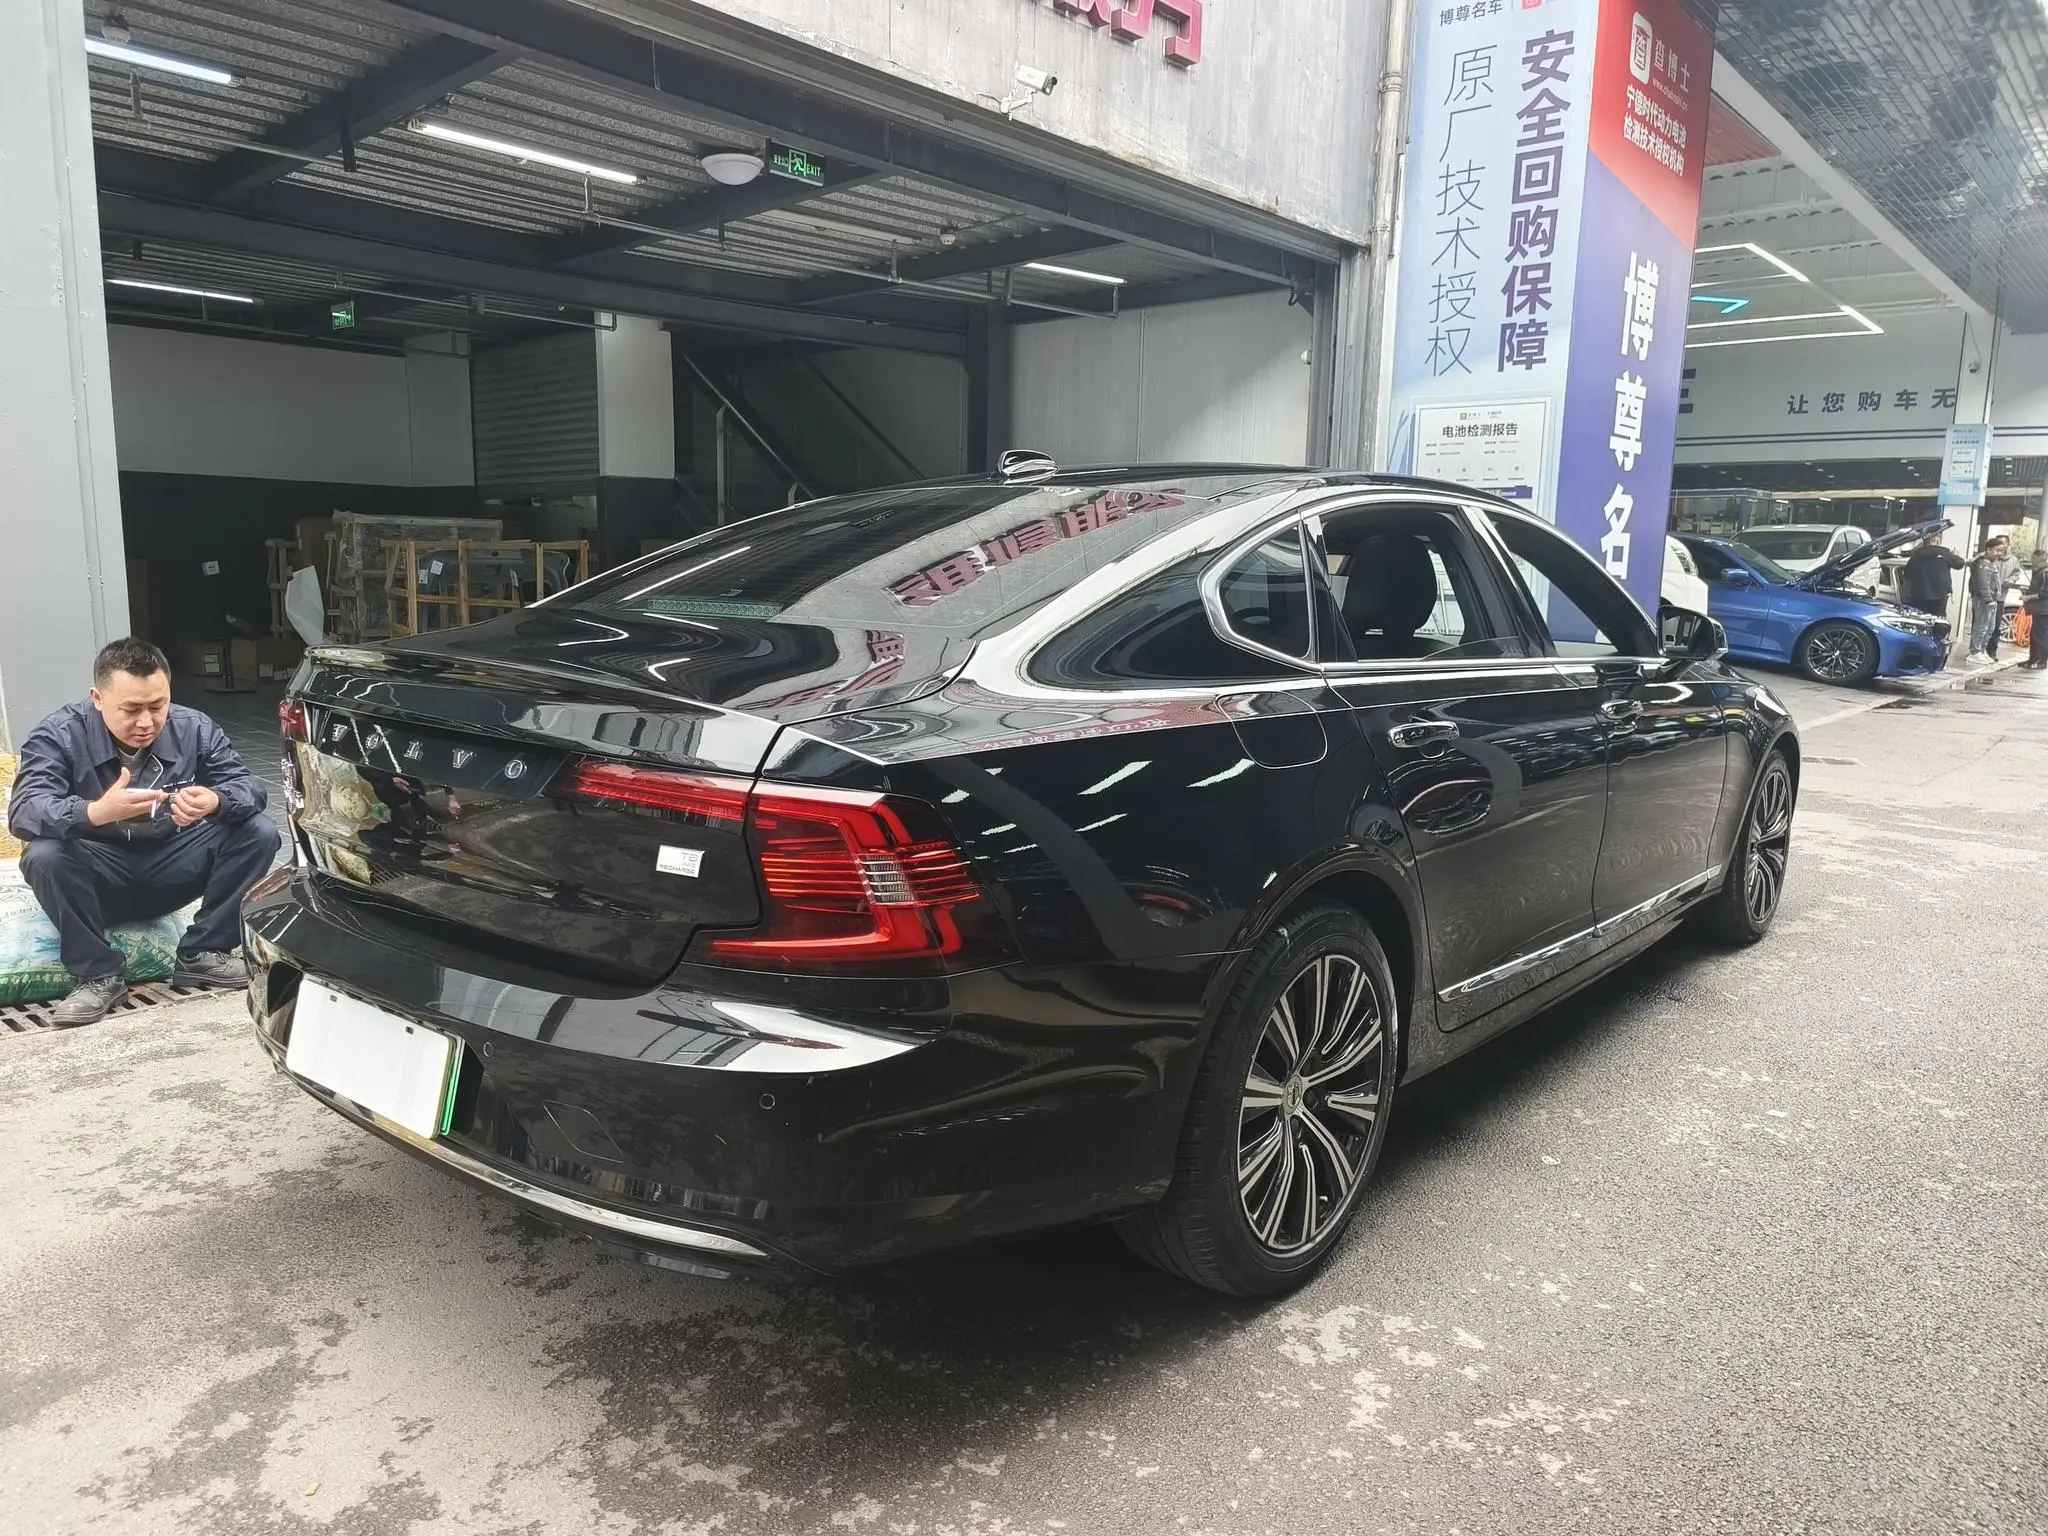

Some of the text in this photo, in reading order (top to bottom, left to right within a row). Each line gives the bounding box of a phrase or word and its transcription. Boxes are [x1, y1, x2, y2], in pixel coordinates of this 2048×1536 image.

[1440, 0, 1503, 27] 博尊名车
[1623, 112, 1685, 177] 检测技术授权机构
[1626, 84, 1687, 149] 宁德时代动力电池
[806, 164, 821, 177] EXIT
[1424, 44, 1498, 377] 原厂技术授权
[1498, 29, 1575, 373] 安全回购保障
[1442, 422, 1519, 438] 电池检测报告
[332, 723, 528, 779] VOLVO
[659, 863, 696, 875] RECHARGE
